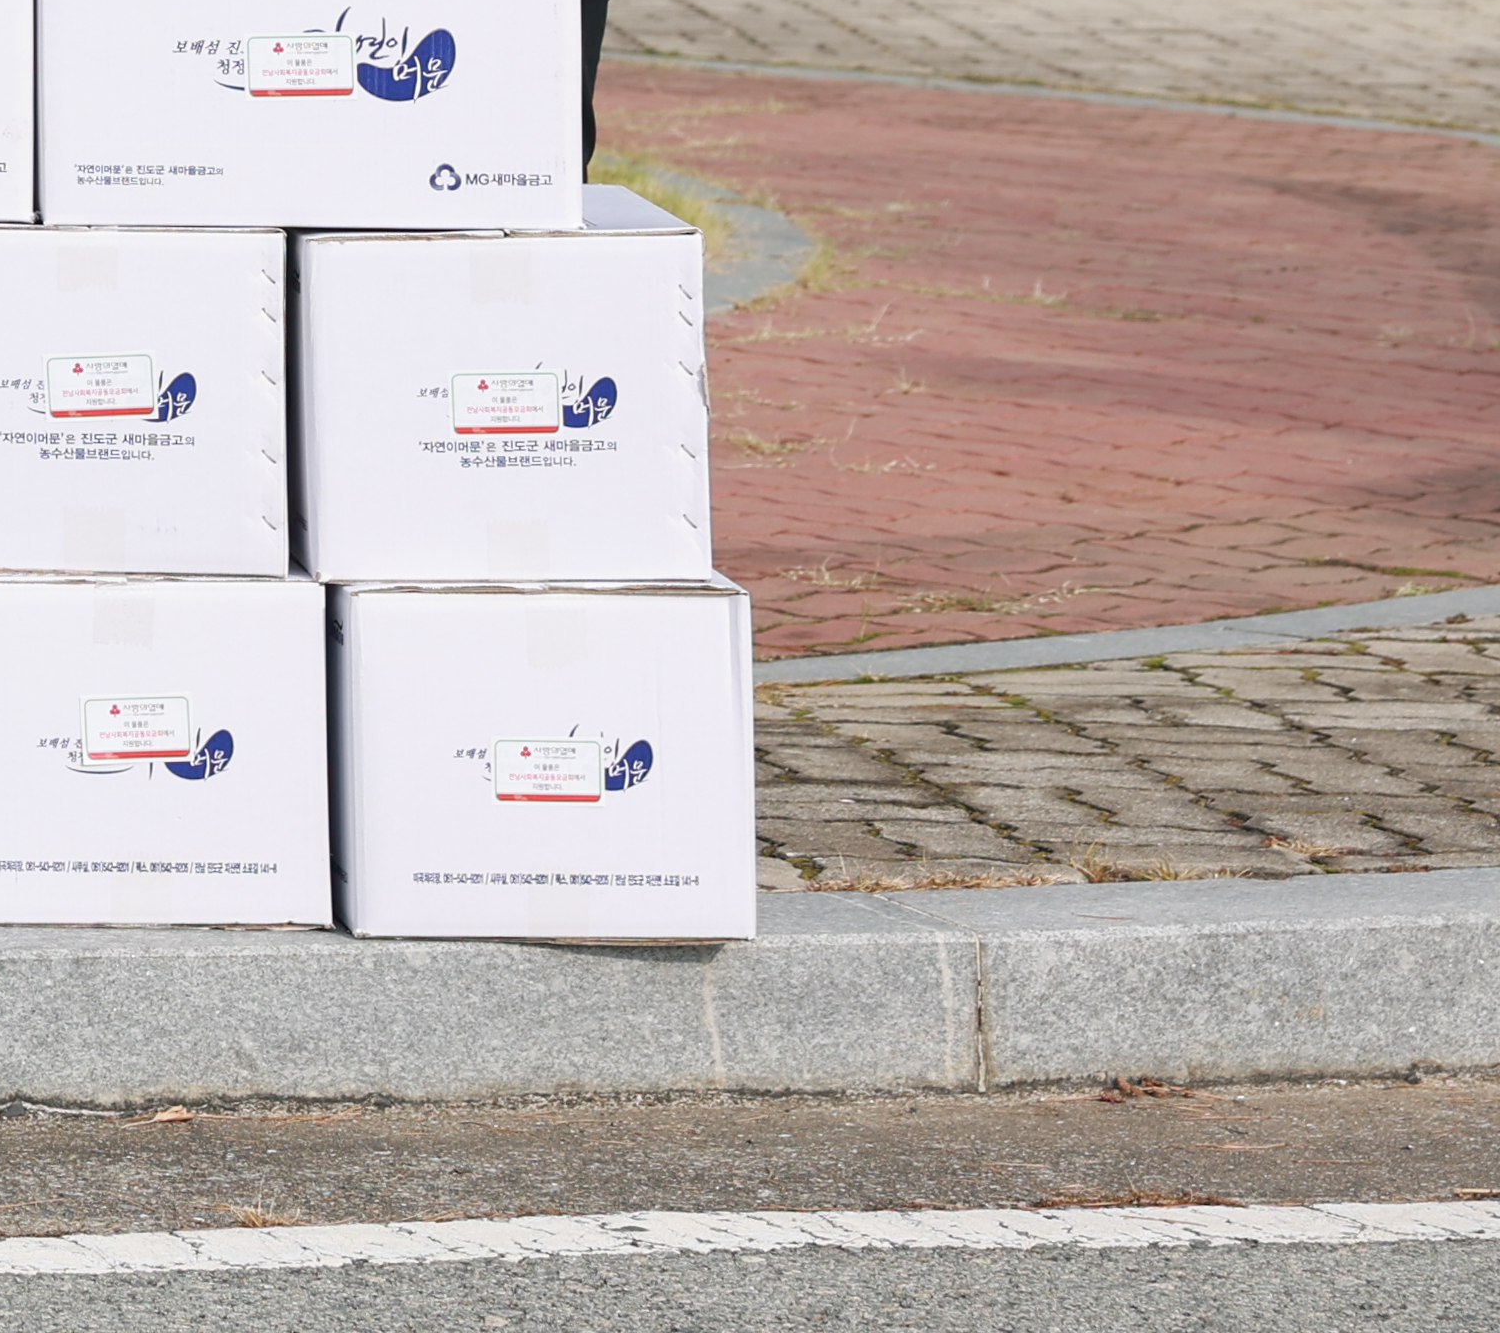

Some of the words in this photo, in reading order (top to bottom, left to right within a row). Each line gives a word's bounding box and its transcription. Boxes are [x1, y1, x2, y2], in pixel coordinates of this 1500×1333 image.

[394, 57, 448, 103] 머문
[136, 164, 165, 176] 진도군
[168, 165, 223, 175] 새마을금고의
[78, 176, 161, 185] 농수산물브랜드입니다.
[81, 434, 117, 445] 진도군
[122, 434, 194, 446] 새마을금고의
[502, 441, 538, 452] 진도군
[544, 440, 616, 451] 새마을금고의
[40, 448, 151, 460] 농수산물브랜드입니다.
[461, 456, 576, 468] 농수산물브랜드입니다.
